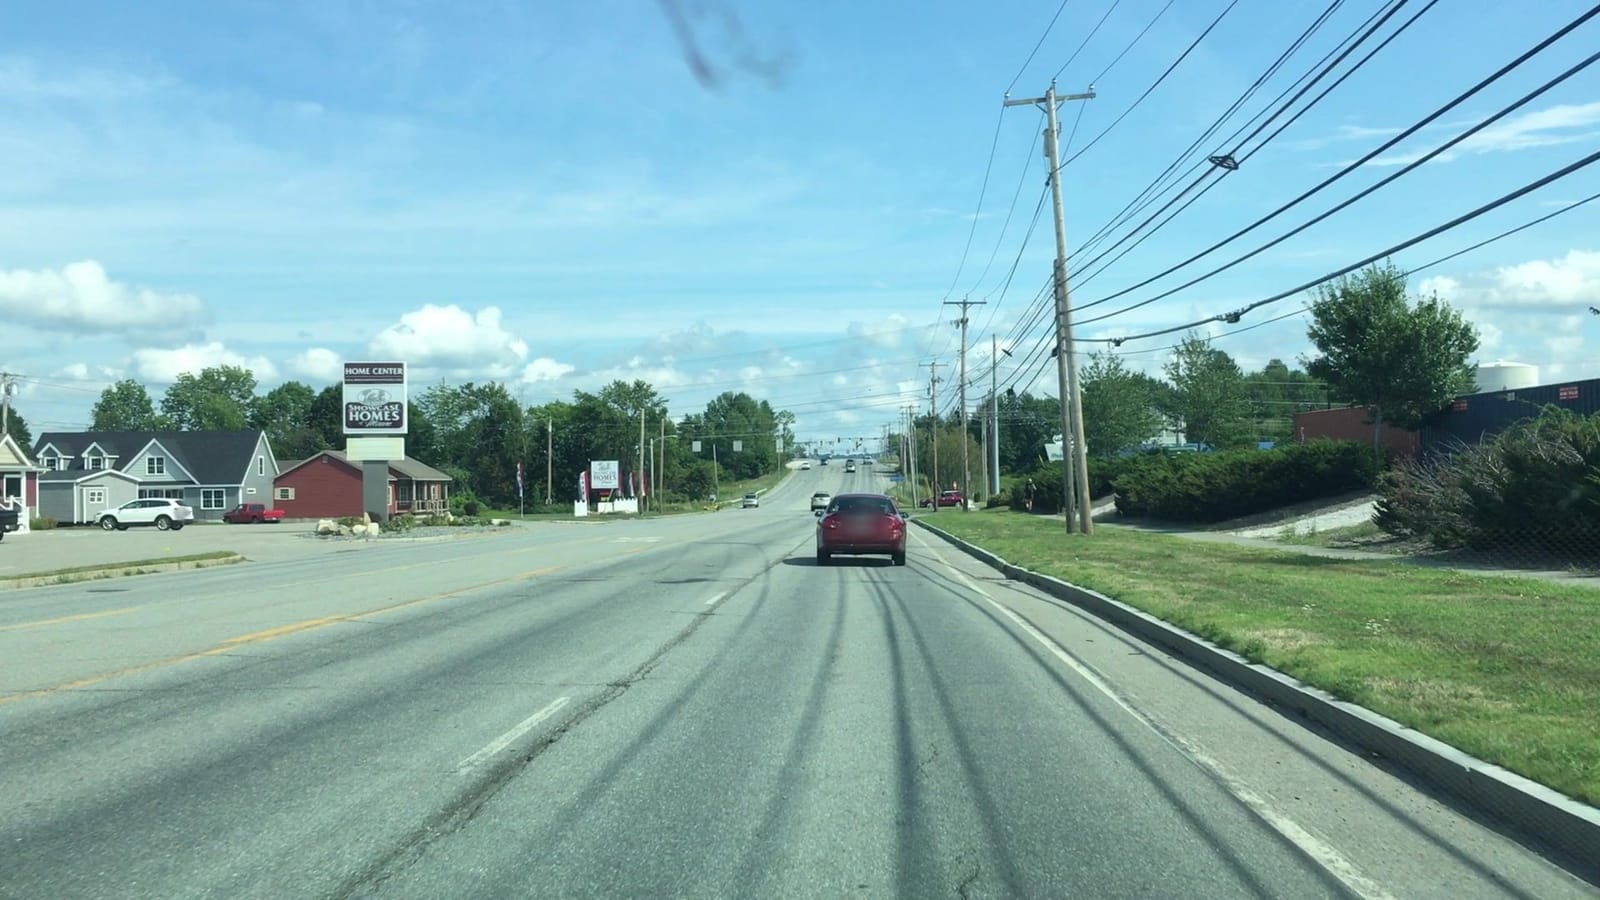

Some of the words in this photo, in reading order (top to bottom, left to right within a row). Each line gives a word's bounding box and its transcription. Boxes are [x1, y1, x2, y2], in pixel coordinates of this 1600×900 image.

[345, 367, 370, 375] HOME
[372, 367, 404, 375] CENTER
[349, 411, 400, 421] HOMES
